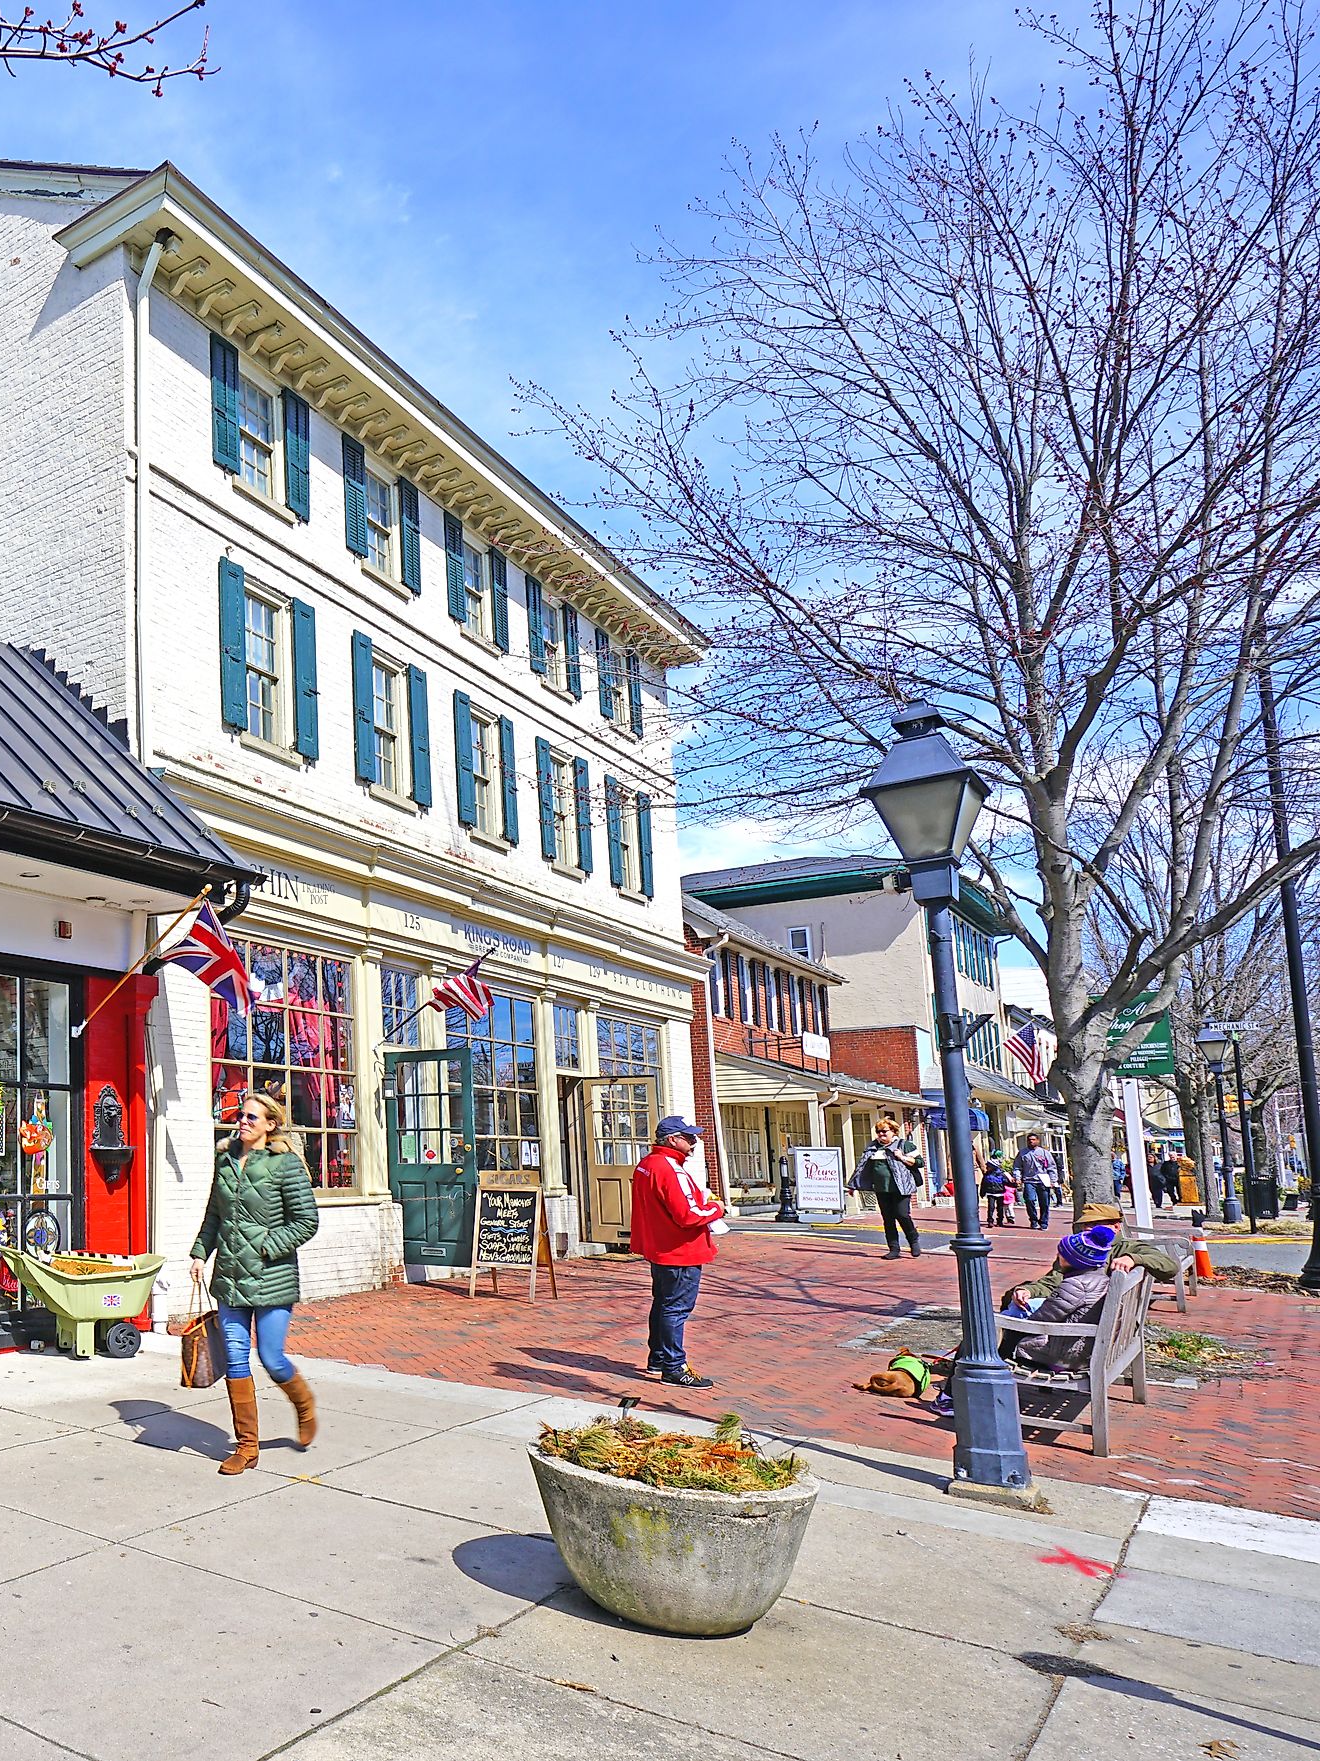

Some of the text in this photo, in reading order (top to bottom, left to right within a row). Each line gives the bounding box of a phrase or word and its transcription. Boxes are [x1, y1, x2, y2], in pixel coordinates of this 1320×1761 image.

[301, 882, 335, 893] TRADING
[310, 894, 328, 905] POST
[403, 912, 421, 931] 125
[464, 923, 531, 956] KING'S ROAD
[635, 978, 683, 1000] CLOTHING
[36, 1178, 60, 1190] GIFTS
[487, 1173, 531, 1185] CIGARS
[496, 1208, 519, 1219] MEETS
[480, 1216, 508, 1227] GENERAL
[1071, 1235, 1097, 1258] STATE
